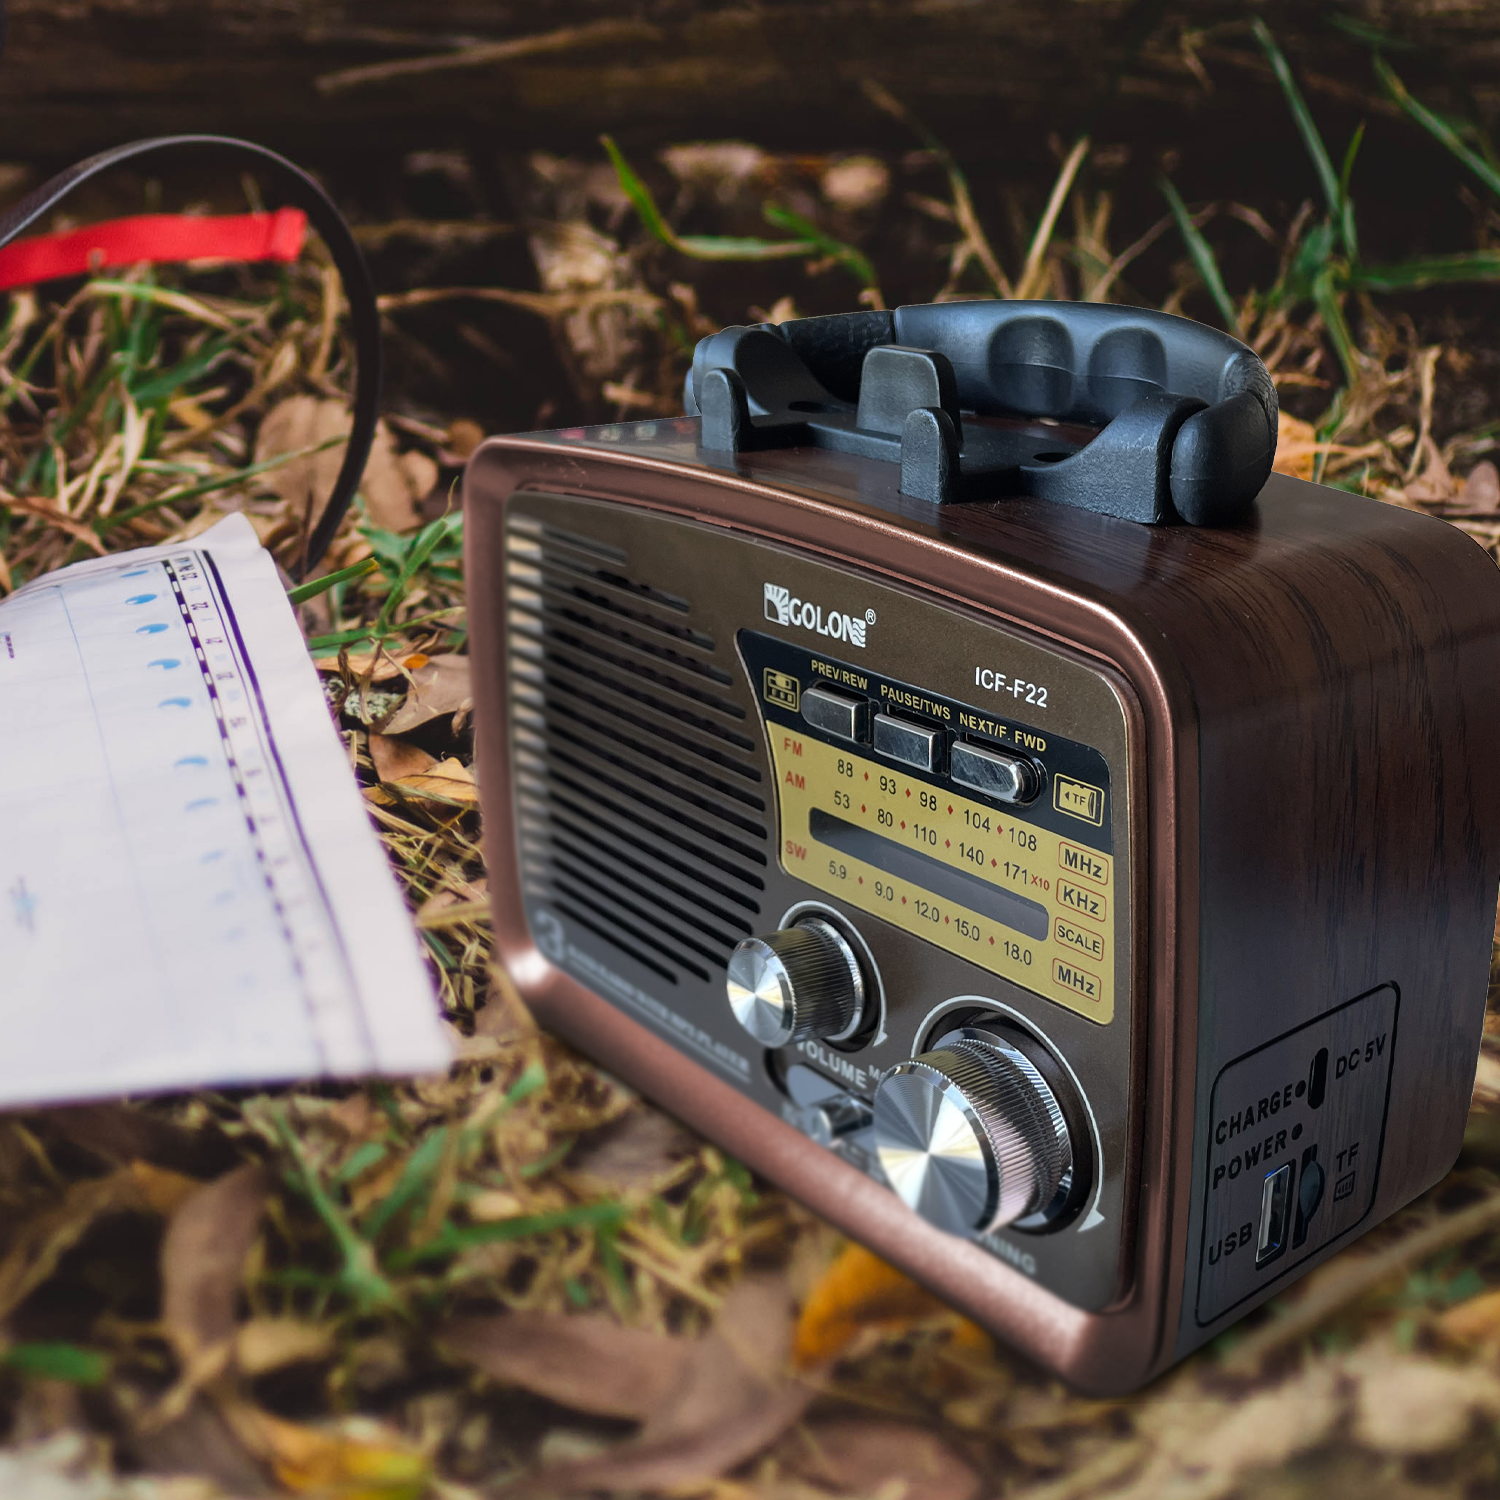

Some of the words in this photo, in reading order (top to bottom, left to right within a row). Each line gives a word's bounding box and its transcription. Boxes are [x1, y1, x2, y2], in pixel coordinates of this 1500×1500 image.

[811, 659, 868, 691] PREV/REW
[975, 666, 1048, 708] ICF-F22
[881, 684, 951, 720] PAUSE/TWS
[1015, 730, 1047, 753] FWD
[784, 737, 803, 757] FM
[837, 759, 853, 778] 88
[879, 775, 896, 795] 93
[919, 791, 937, 811] 98
[964, 808, 991, 833] 104
[1009, 827, 1037, 851] 108
[1072, 792, 1086, 807] TF
[785, 770, 806, 790] AM
[834, 790, 850, 809] 53
[877, 808, 893, 827] 80
[913, 823, 937, 846] 110
[959, 842, 984, 866] 140
[1004, 861, 1028, 885] 171
[1064, 848, 1102, 879] MHz
[785, 839, 807, 861] SW
[829, 860, 847, 880] 5.9
[875, 881, 894, 901] 9.0
[914, 899, 940, 923] 12.0
[954, 917, 980, 942] 15.0
[1003, 940, 1032, 966] 18.0
[1063, 885, 1100, 916] KHz
[1057, 925, 1101, 955] SCALE
[1058, 964, 1095, 996] MHz
[1335, 1048, 1361, 1080] DC
[1364, 1033, 1387, 1063] 5V
[1215, 1083, 1293, 1146] CHARGE
[1213, 1129, 1288, 1190] POWER
[1336, 1142, 1360, 1173] TF
[1208, 1222, 1253, 1266] USB
